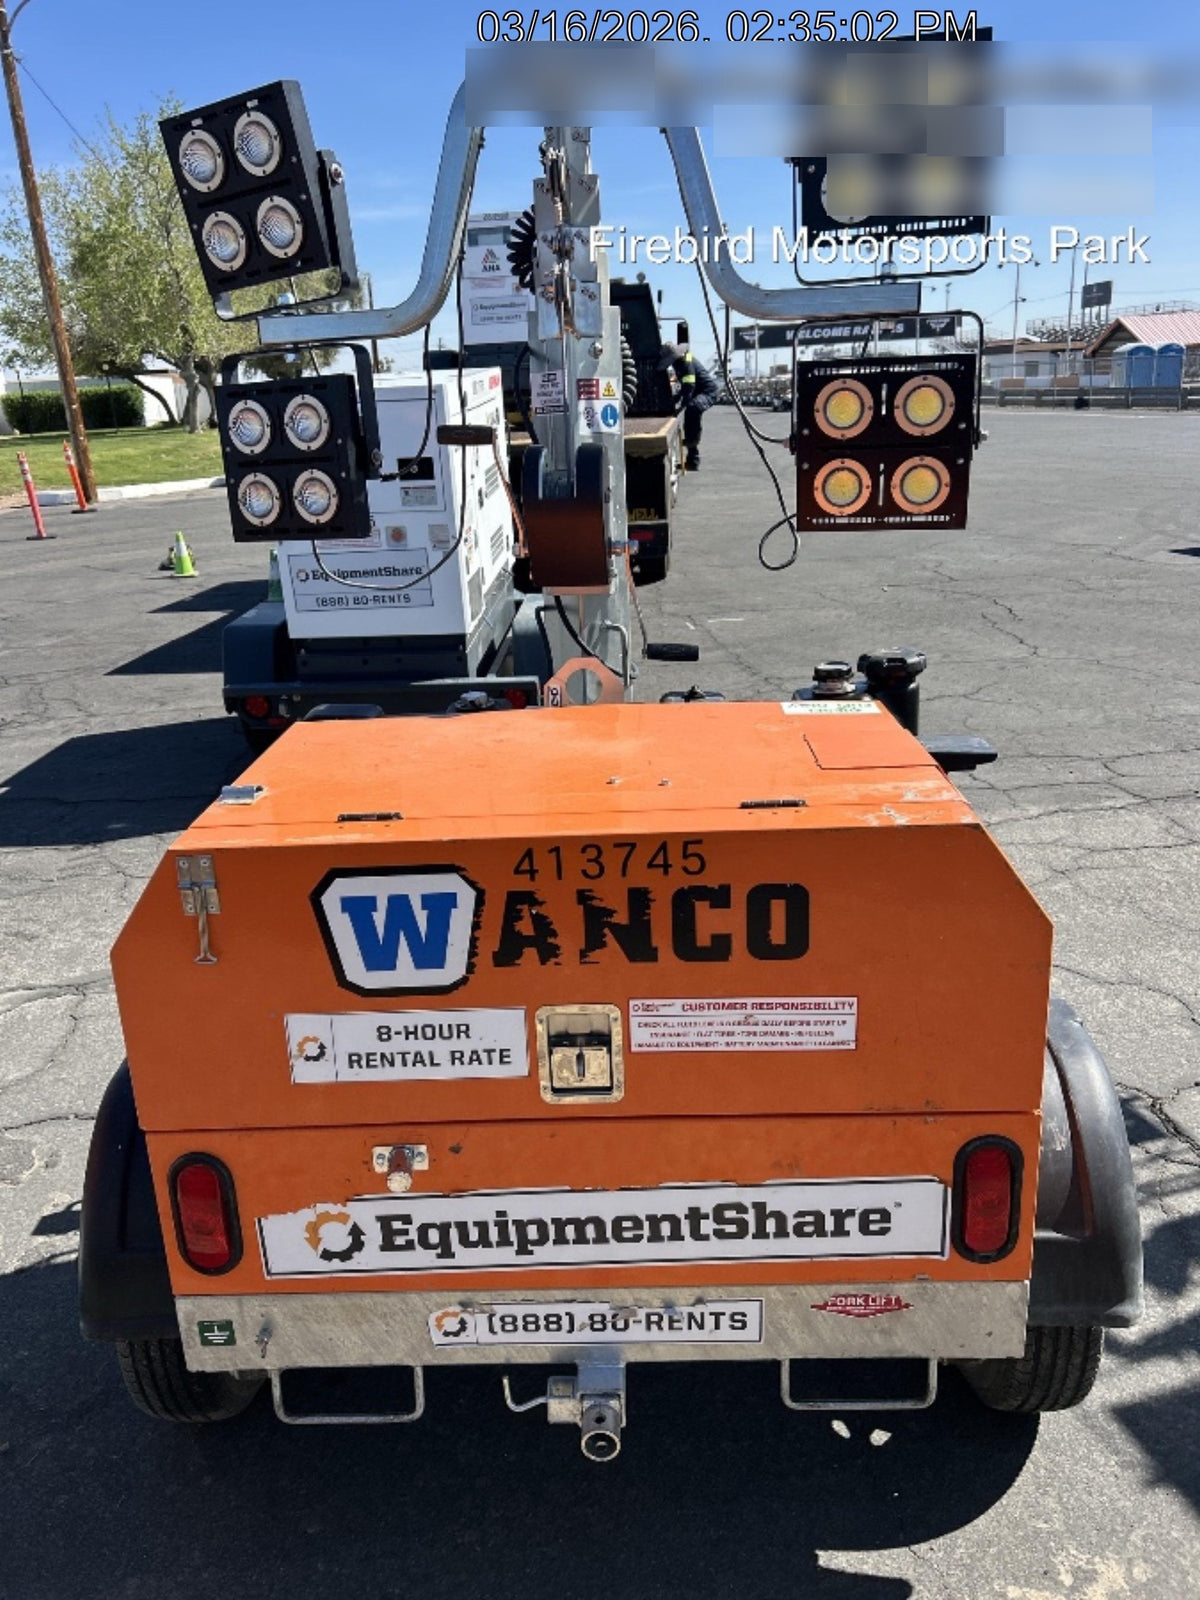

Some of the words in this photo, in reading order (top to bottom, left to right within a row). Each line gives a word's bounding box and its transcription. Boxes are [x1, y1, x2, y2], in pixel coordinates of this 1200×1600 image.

[786, 326, 851, 340] WELCOME
[311, 566, 423, 582] EqipmentShare
[514, 839, 707, 882] 413745
[340, 883, 810, 972] WANCO
[682, 1002, 748, 1012] CUSTOMER
[751, 1001, 854, 1011] RESPONSIBILITY
[376, 1023, 471, 1042] 8-HOUR
[348, 1051, 441, 1069] RENTAL
[450, 1048, 512, 1066] RATE
[375, 1202, 891, 1259] EquipmentShare
[828, 1296, 866, 1306] FORK
[869, 1295, 897, 1305] LIFT
[487, 1312, 575, 1335] (888)
[588, 1311, 747, 1333] 80-RENTS
